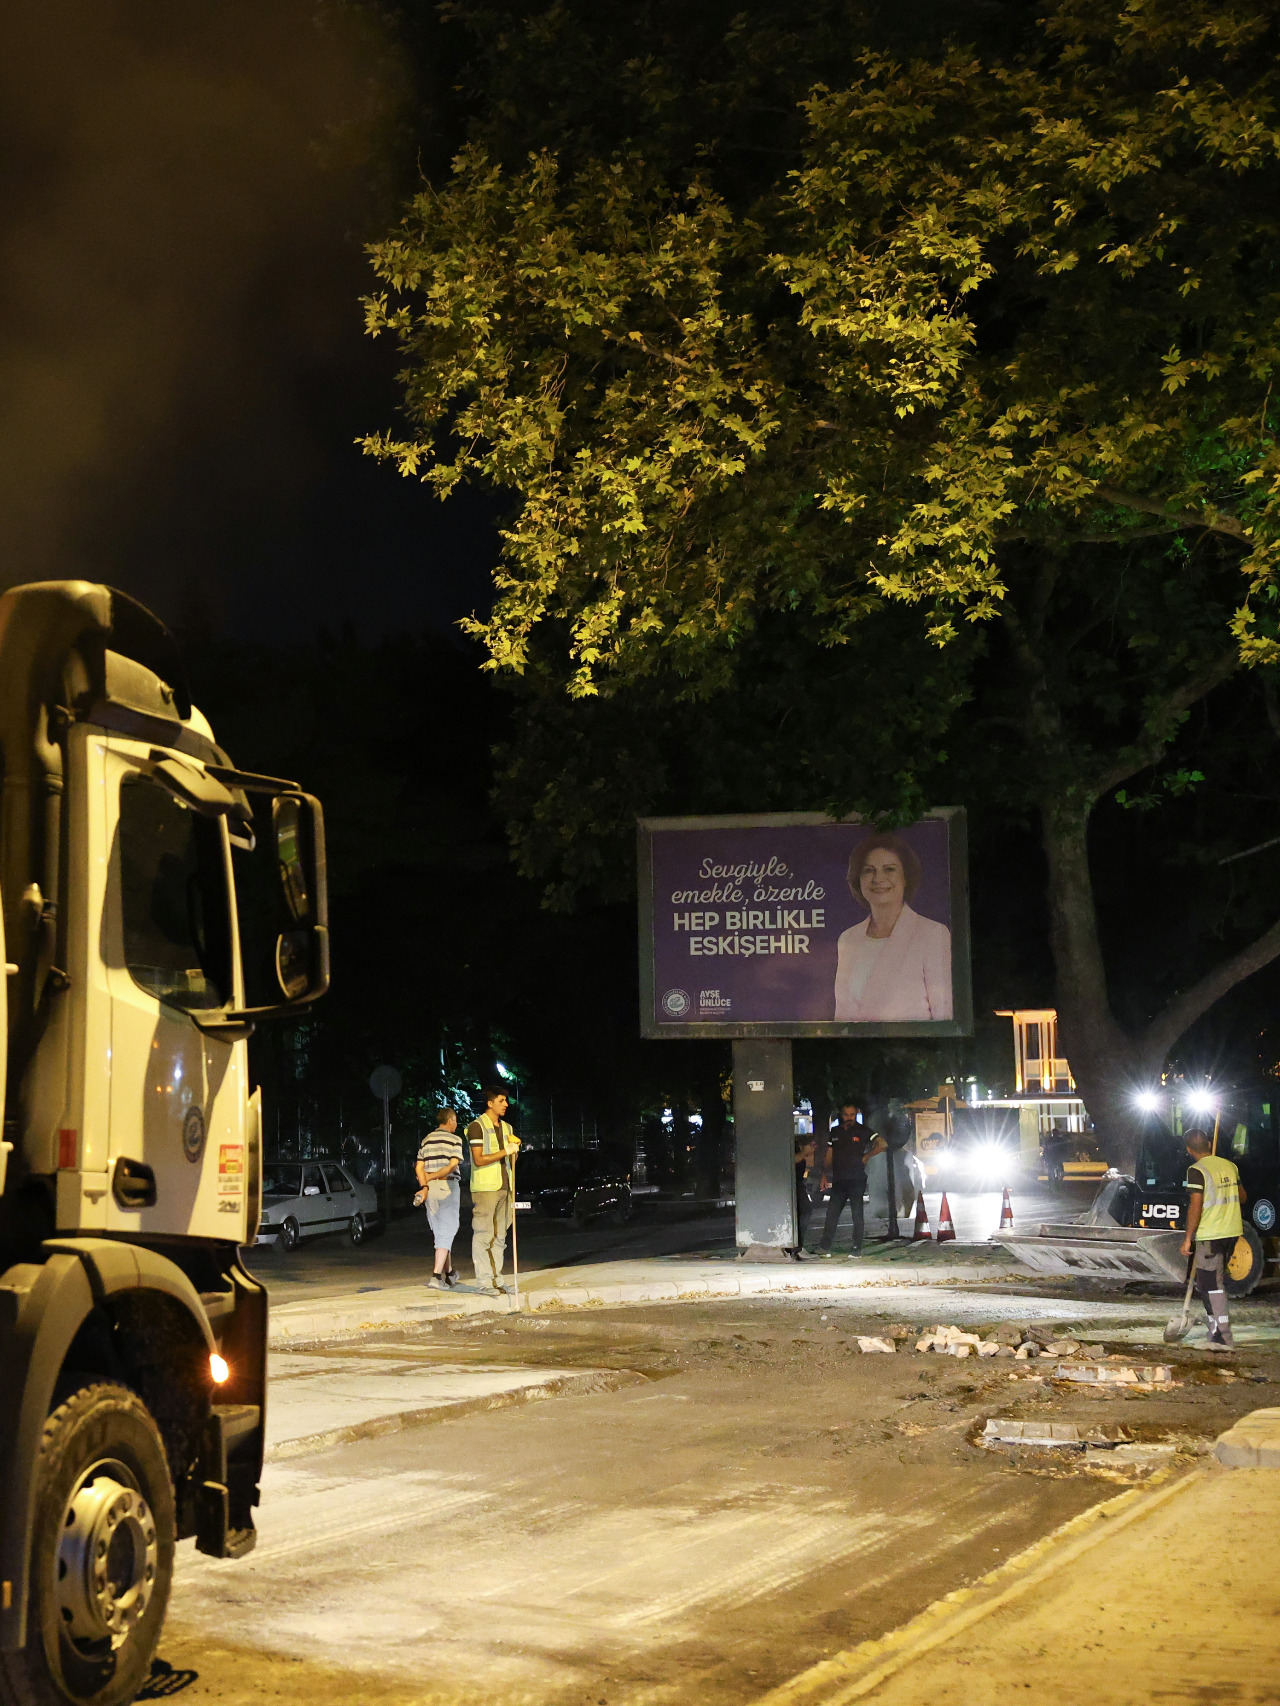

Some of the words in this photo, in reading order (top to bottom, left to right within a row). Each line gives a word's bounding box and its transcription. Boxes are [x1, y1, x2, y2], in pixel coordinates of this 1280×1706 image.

[699, 856, 794, 885] Sevgiyle,
[671, 882, 749, 906] emekle,
[753, 880, 826, 902] özenle
[673, 911, 720, 931] HEP
[725, 905, 826, 930] BİRLİKLE
[689, 930, 810, 958] ESKİŞEHİR
[1142, 1204, 1180, 1219] JCB
